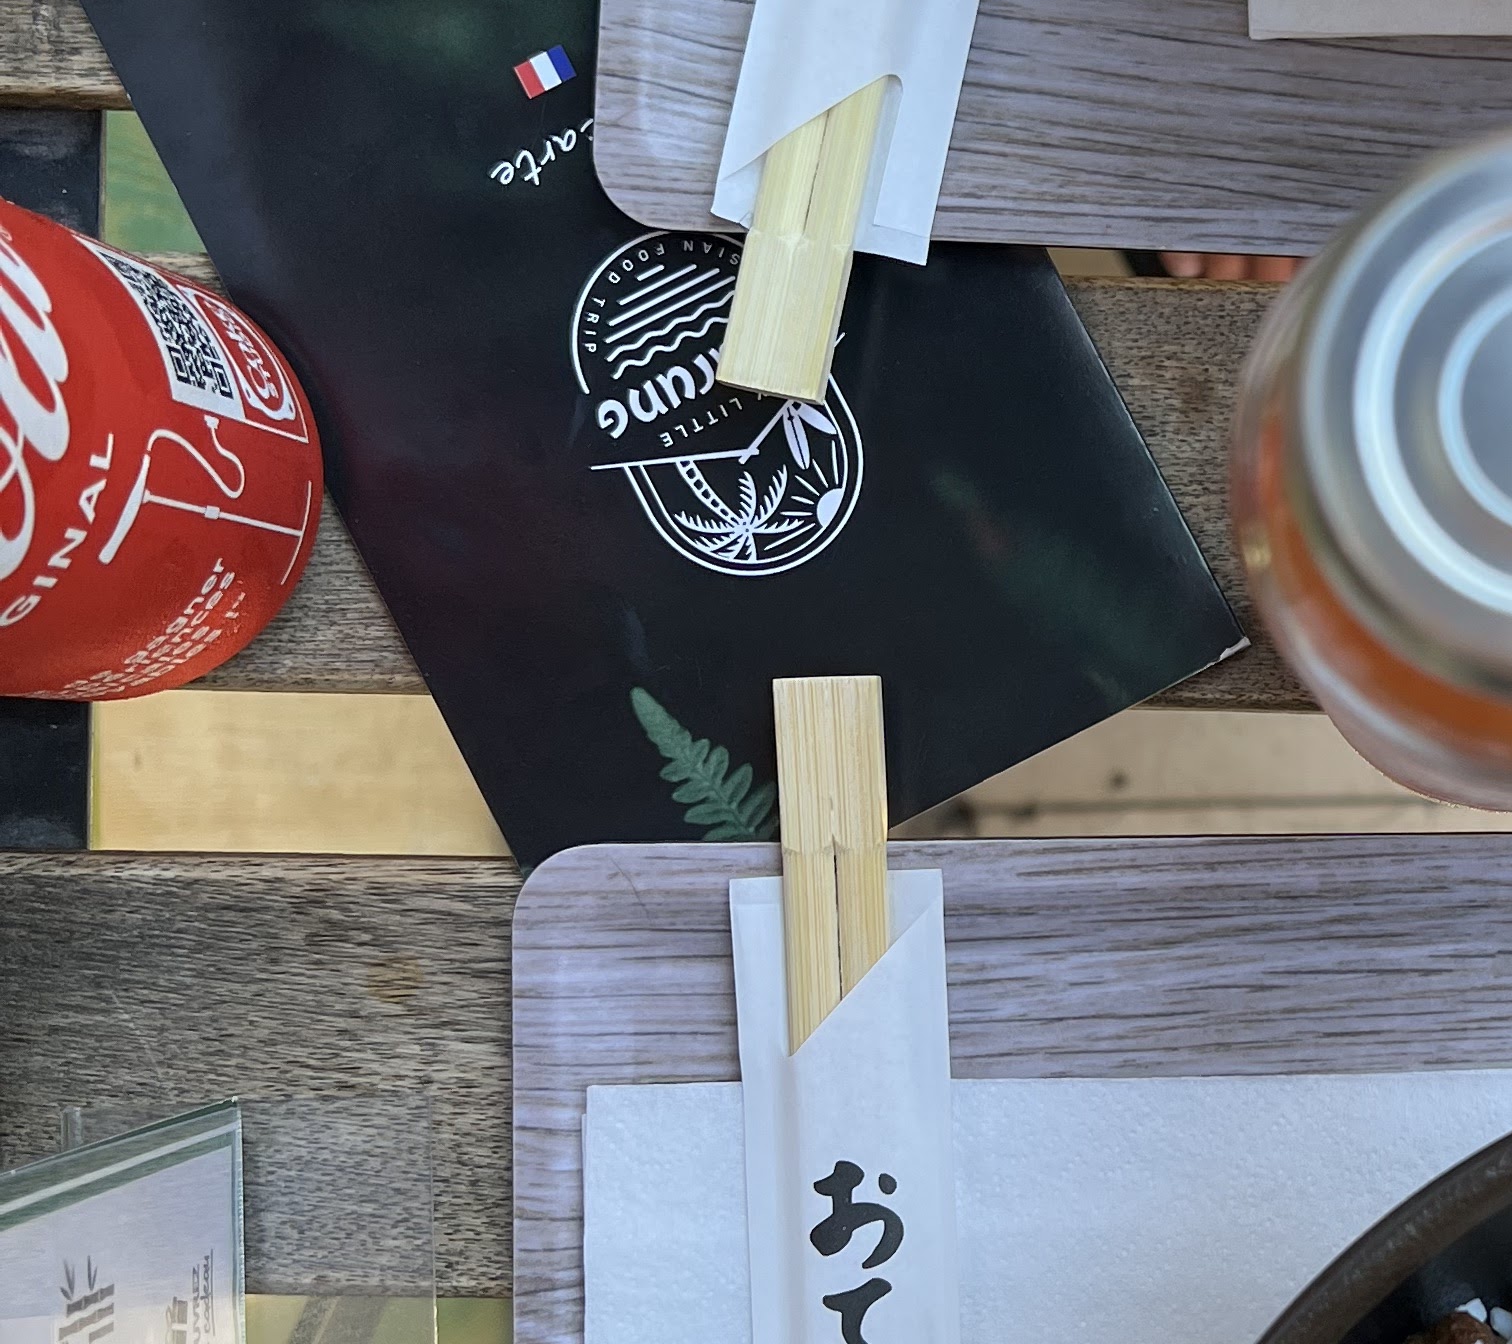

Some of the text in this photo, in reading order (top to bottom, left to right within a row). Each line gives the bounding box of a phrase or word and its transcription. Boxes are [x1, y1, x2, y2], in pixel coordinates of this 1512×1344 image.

[583, 240, 740, 353] SIAN FOOD TRIP
[659, 397, 743, 448] LITTLE
[0, 432, 115, 626] GINAL
